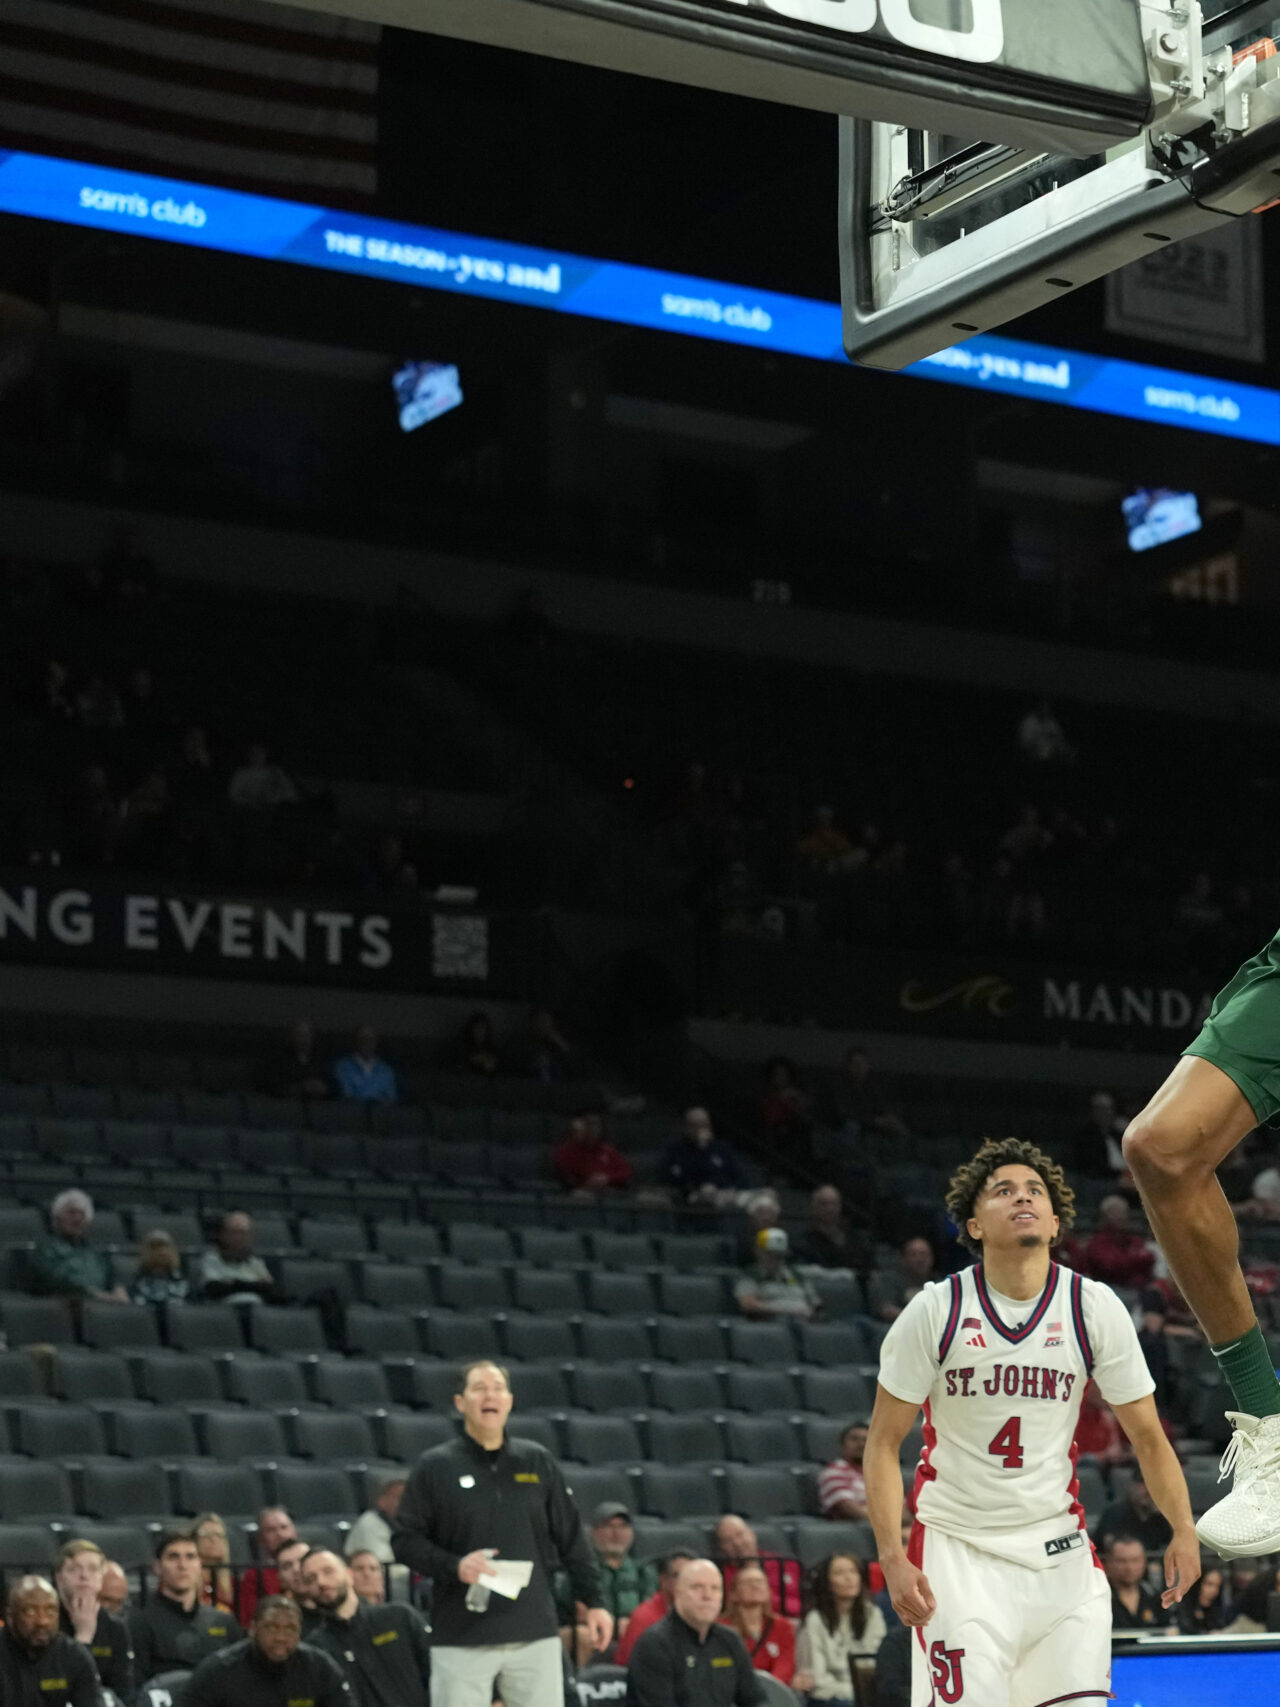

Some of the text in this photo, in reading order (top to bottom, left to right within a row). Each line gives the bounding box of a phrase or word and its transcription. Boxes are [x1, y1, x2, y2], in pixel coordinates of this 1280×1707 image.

[151, 196, 207, 228] club
[324, 229, 363, 258] THE
[366, 238, 447, 272] SEASON
[455, 254, 505, 284] yes
[506, 263, 561, 294] and
[723, 302, 772, 332] club
[979, 353, 1021, 380] yes
[1023, 361, 1070, 389] and
[123, 894, 393, 970] EVENTS
[945, 1364, 1076, 1402] ST. JOHN'S
[988, 1416, 1024, 1468] 4
